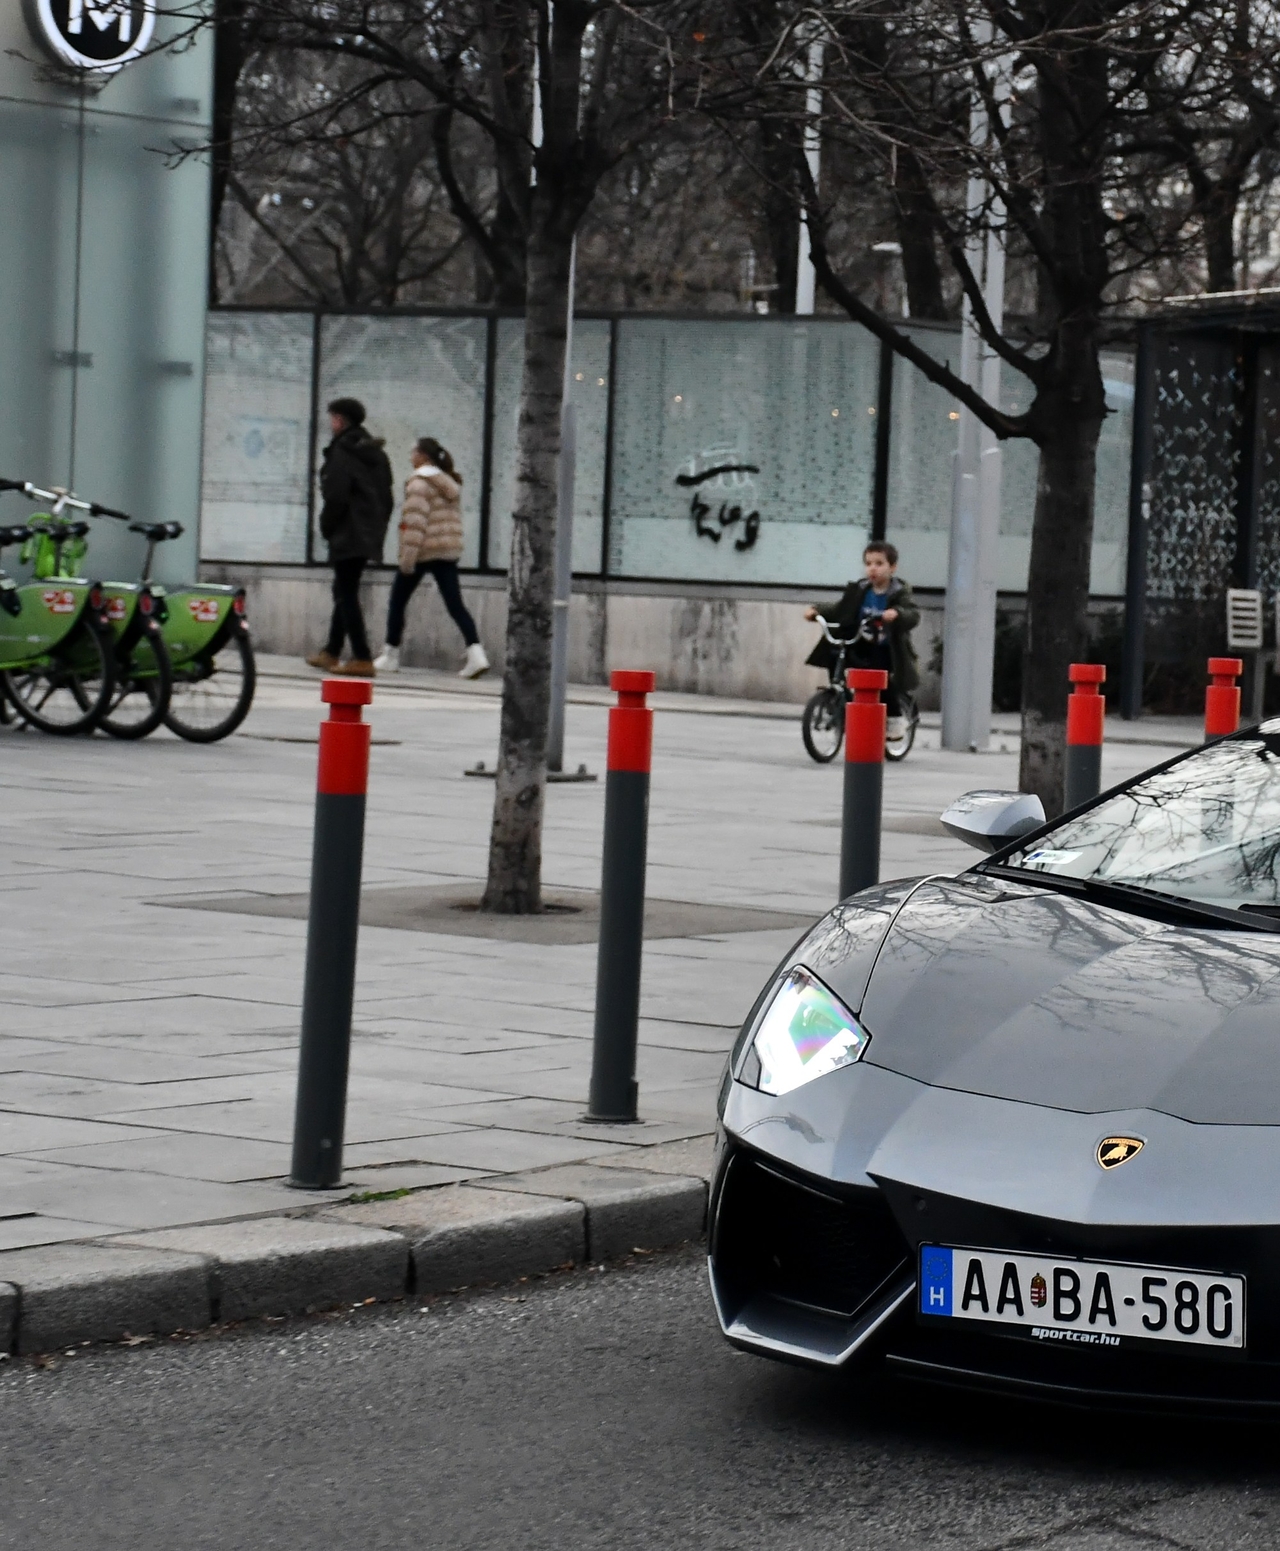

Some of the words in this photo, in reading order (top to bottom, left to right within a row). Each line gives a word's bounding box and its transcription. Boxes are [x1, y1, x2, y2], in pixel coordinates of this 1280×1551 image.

[68, 0, 131, 42] M
[929, 1286, 945, 1307] H
[1031, 1327, 1121, 1346] sportcar.hu
